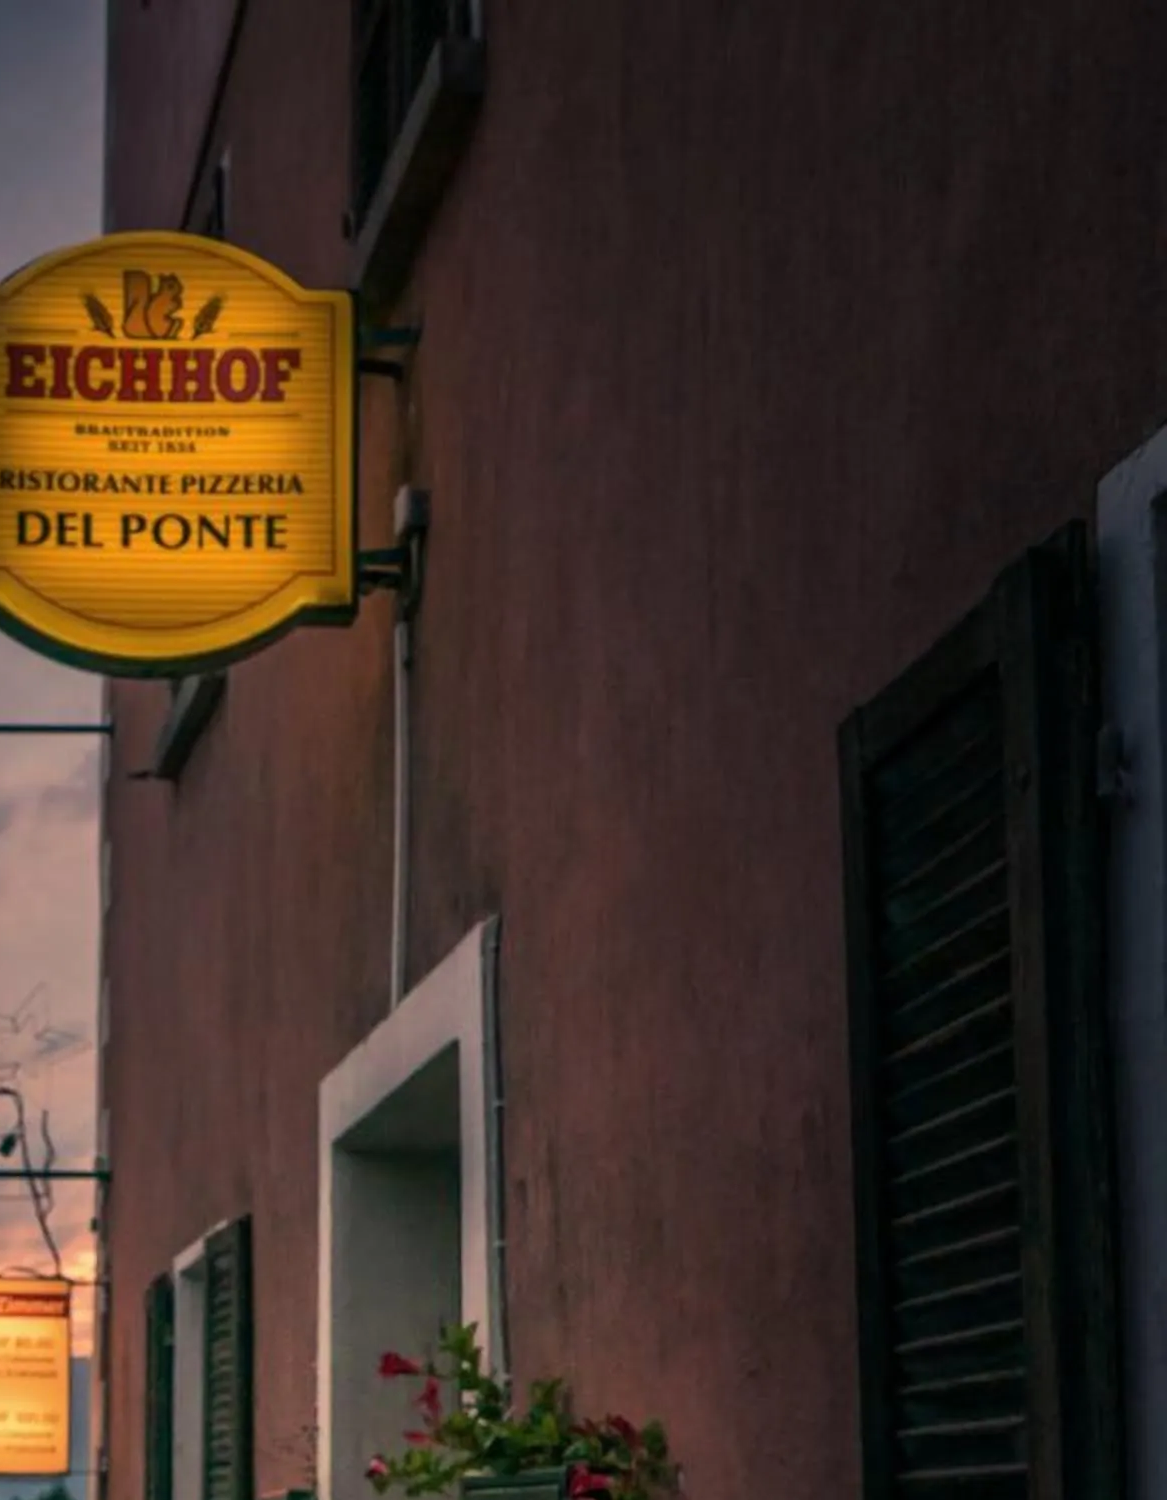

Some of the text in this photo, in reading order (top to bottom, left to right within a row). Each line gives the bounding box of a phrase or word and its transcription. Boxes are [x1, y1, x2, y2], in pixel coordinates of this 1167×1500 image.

[5, 344, 301, 403] EICHHOF
[74, 423, 230, 437] BRAUTRADITION
[108, 440, 151, 453] SEIT
[180, 474, 304, 495] PIZZERIA
[16, 510, 288, 549] DEL PONTE
